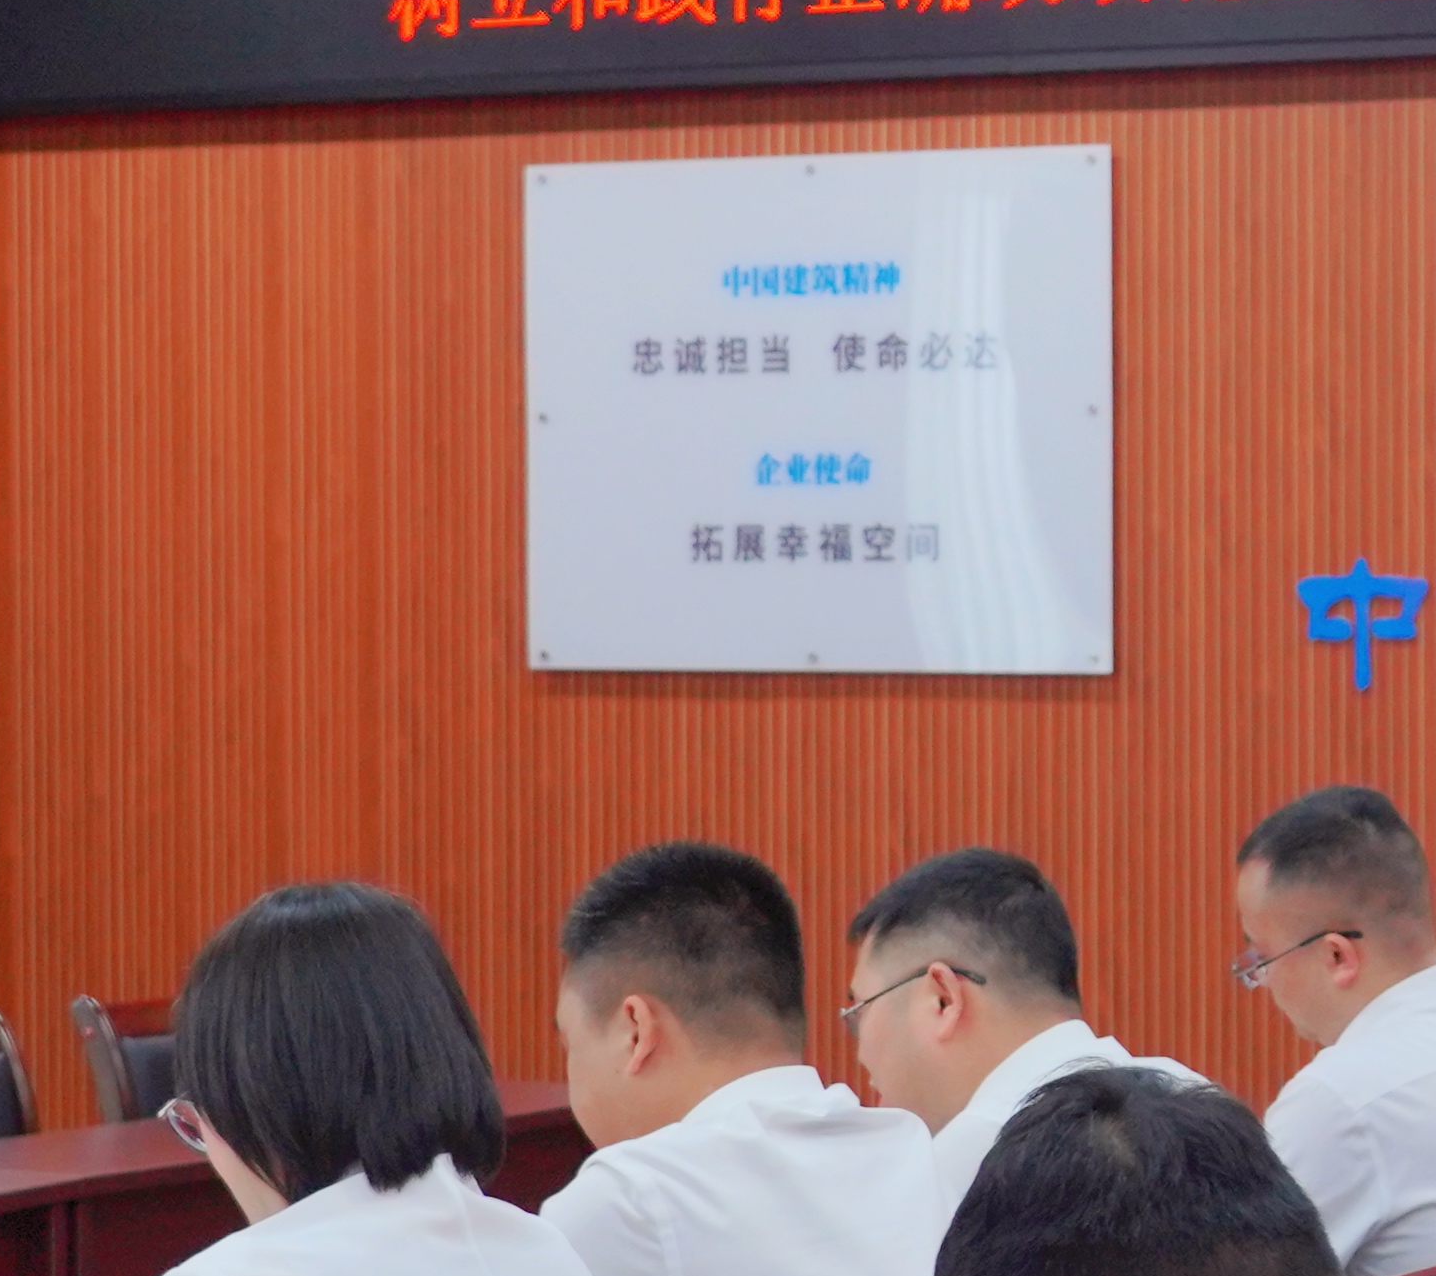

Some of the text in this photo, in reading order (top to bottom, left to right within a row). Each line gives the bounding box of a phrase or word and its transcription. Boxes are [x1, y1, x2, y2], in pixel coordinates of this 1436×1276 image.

[722, 260, 902, 298] 中国建筑精神
[632, 331, 1000, 377] 忠诚担当 使命必达
[756, 452, 873, 488] 企业使命
[690, 523, 942, 565] 拓展幸福空间
